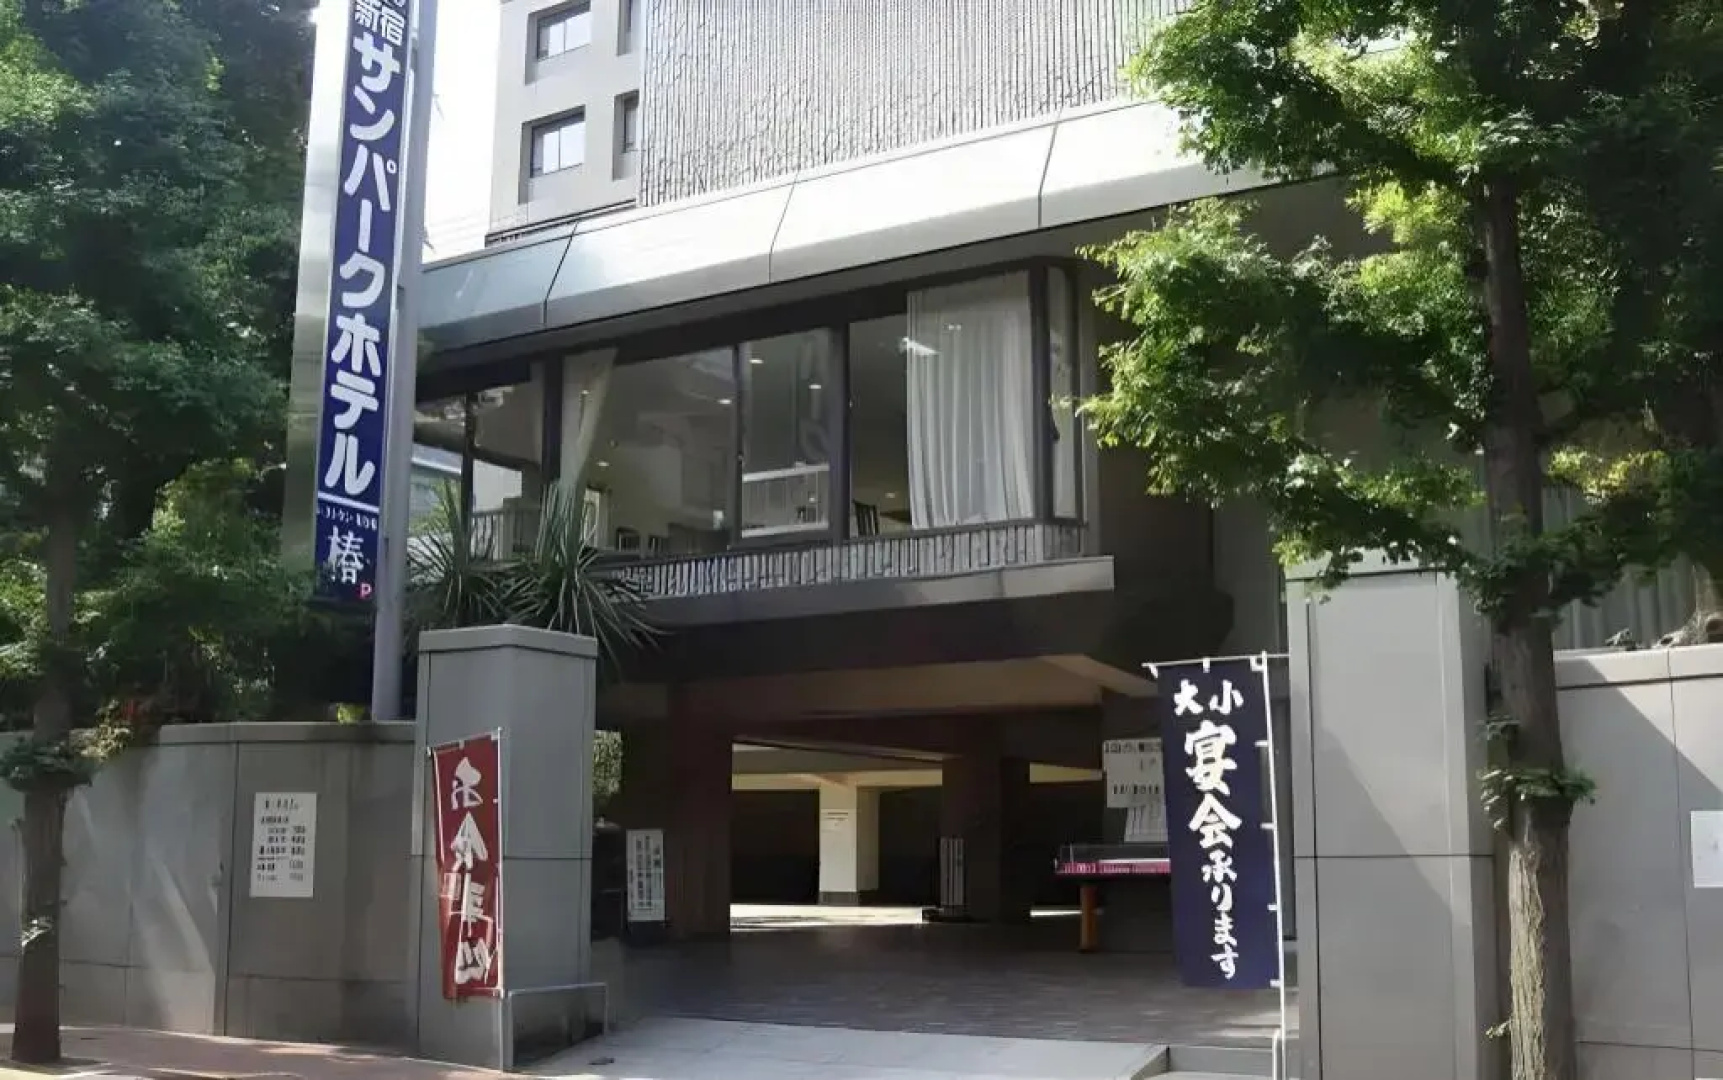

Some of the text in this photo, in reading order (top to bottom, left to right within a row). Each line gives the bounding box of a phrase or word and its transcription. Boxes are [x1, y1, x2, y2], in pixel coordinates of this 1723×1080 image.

[324, 31, 401, 495] サンパークホテル
